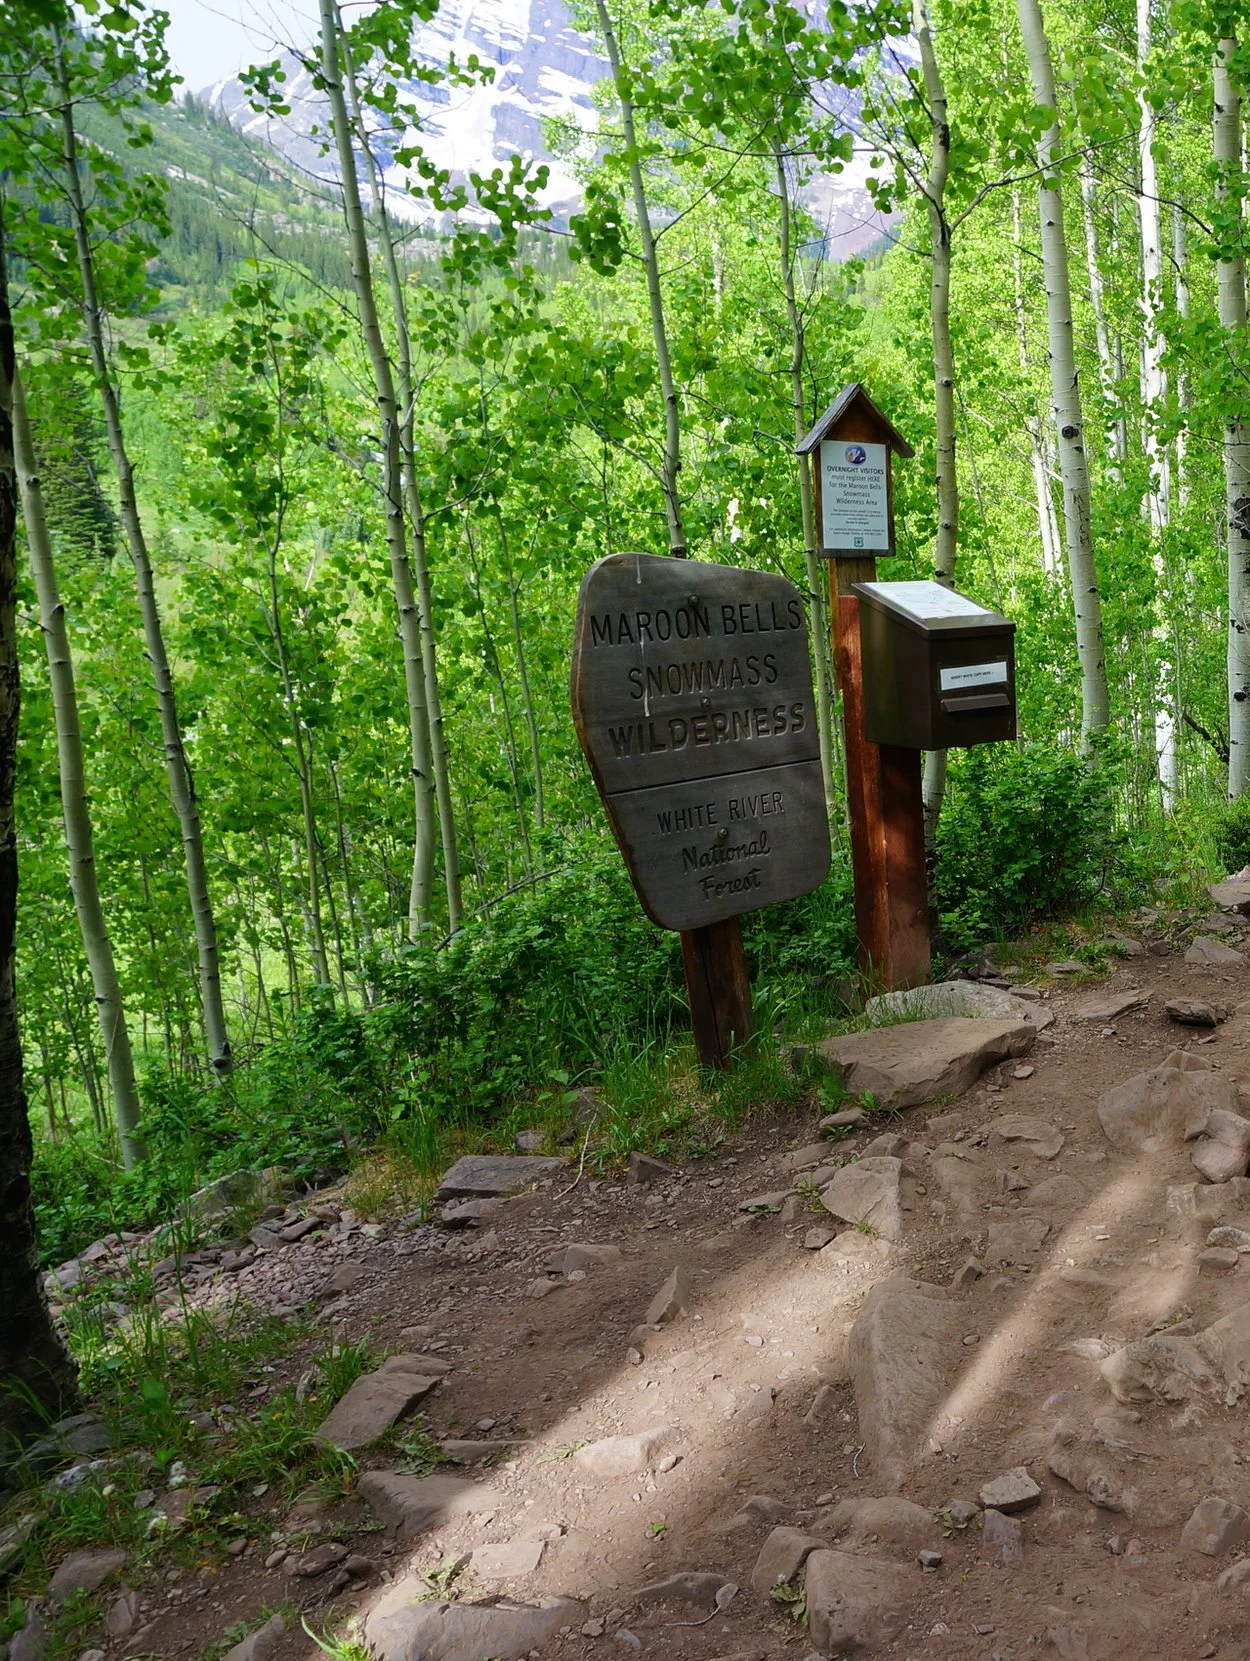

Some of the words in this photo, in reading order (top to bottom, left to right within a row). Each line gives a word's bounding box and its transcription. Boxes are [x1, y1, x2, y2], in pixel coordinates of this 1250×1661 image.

[843, 490, 870, 498] Snowmass
[589, 606, 711, 648] MAROON
[721, 600, 801, 638] BELLS
[628, 653, 779, 701] SNOWMASS
[608, 702, 806, 758] WILDERNESS
[656, 801, 718, 836] WHITE
[729, 790, 785, 824] RIVER
[681, 830, 772, 875] National
[698, 868, 762, 902] Forest
